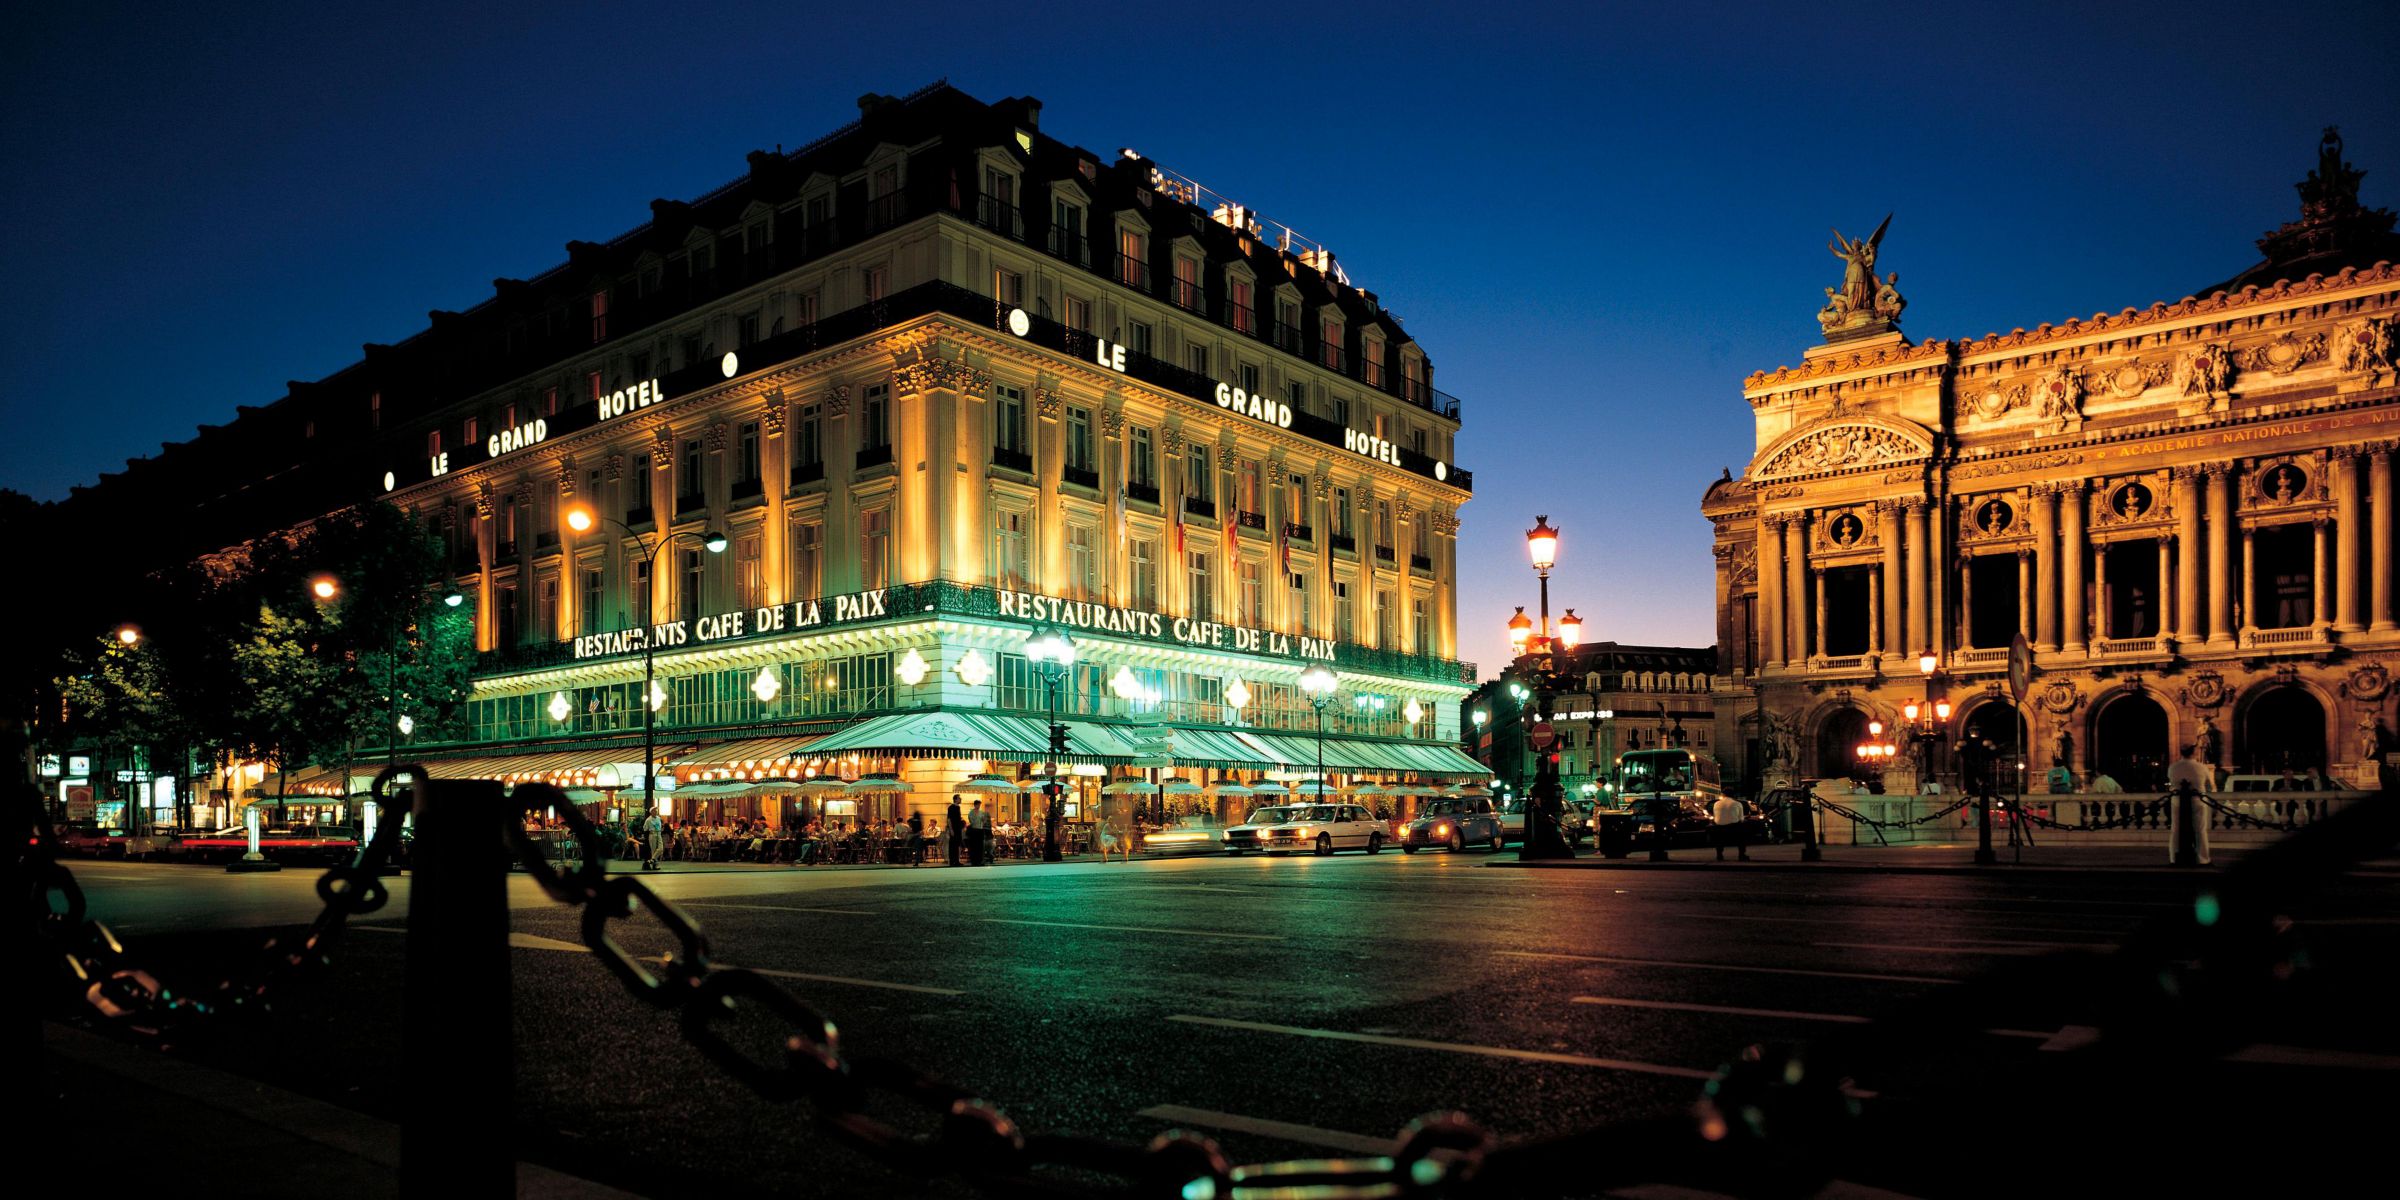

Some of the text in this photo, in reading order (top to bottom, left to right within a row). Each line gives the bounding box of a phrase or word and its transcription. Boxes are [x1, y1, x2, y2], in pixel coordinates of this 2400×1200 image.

[432, 378, 664, 477] LE GRAND HOTEL
[1097, 338, 1401, 467] LE GRAND HOTEL
[2120, 437, 2206, 457] ACADEMIE
[2222, 422, 2311, 443] NATIONALE
[2329, 417, 2353, 430] DE
[696, 611, 744, 641] CAFE
[757, 605, 784, 632] DE
[795, 599, 821, 627] LA
[835, 589, 886, 622] PAIX
[998, 589, 1337, 662] RESTAURANTS CAFE DE LA PAIX
